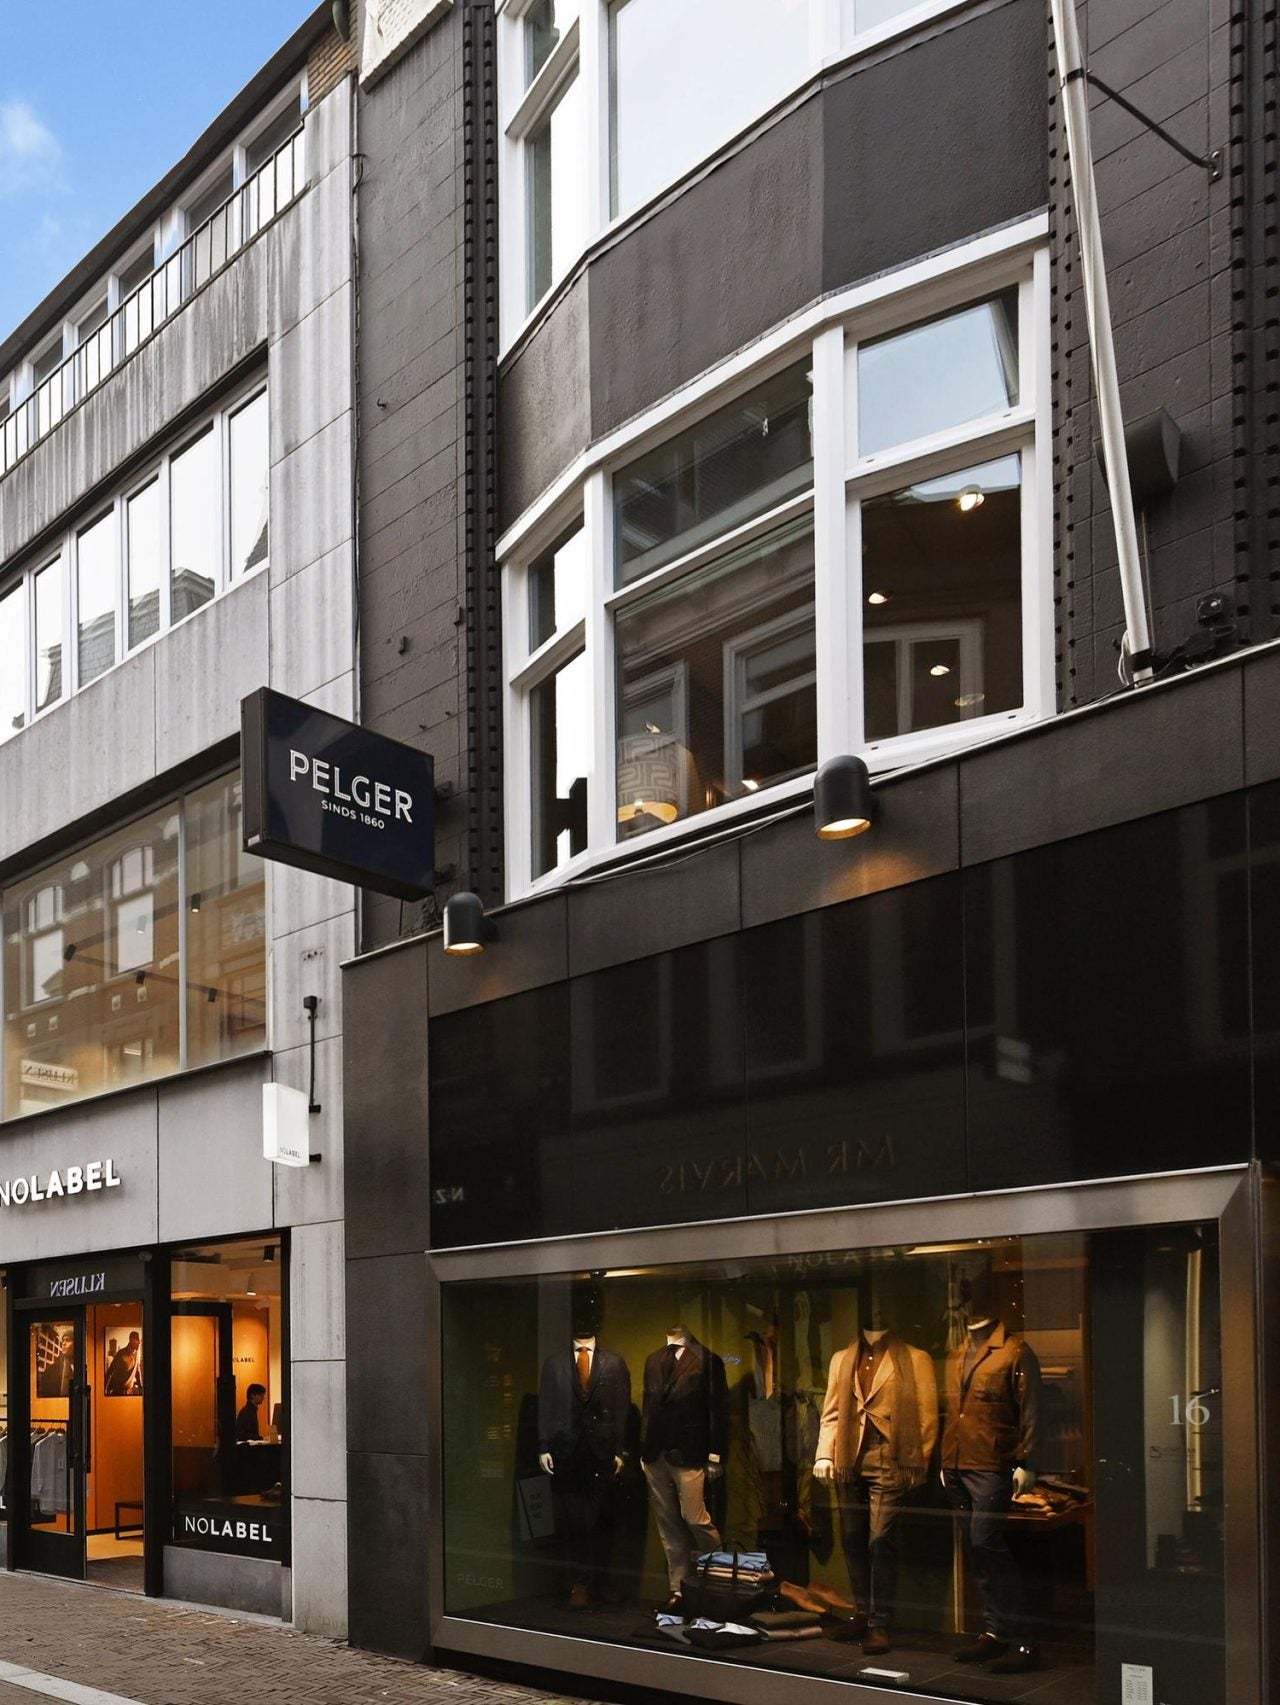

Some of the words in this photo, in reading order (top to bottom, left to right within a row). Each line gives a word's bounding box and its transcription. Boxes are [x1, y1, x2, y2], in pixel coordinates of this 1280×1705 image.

[290, 749, 413, 823] PELGER
[321, 800, 357, 820] SINDS
[360, 812, 385, 830] 1860
[280, 1146, 301, 1159] NOLABEL
[1168, 1394, 1210, 1426] 16
[185, 1516, 272, 1542] NOLABEL
[456, 1573, 504, 1590] PELGER
